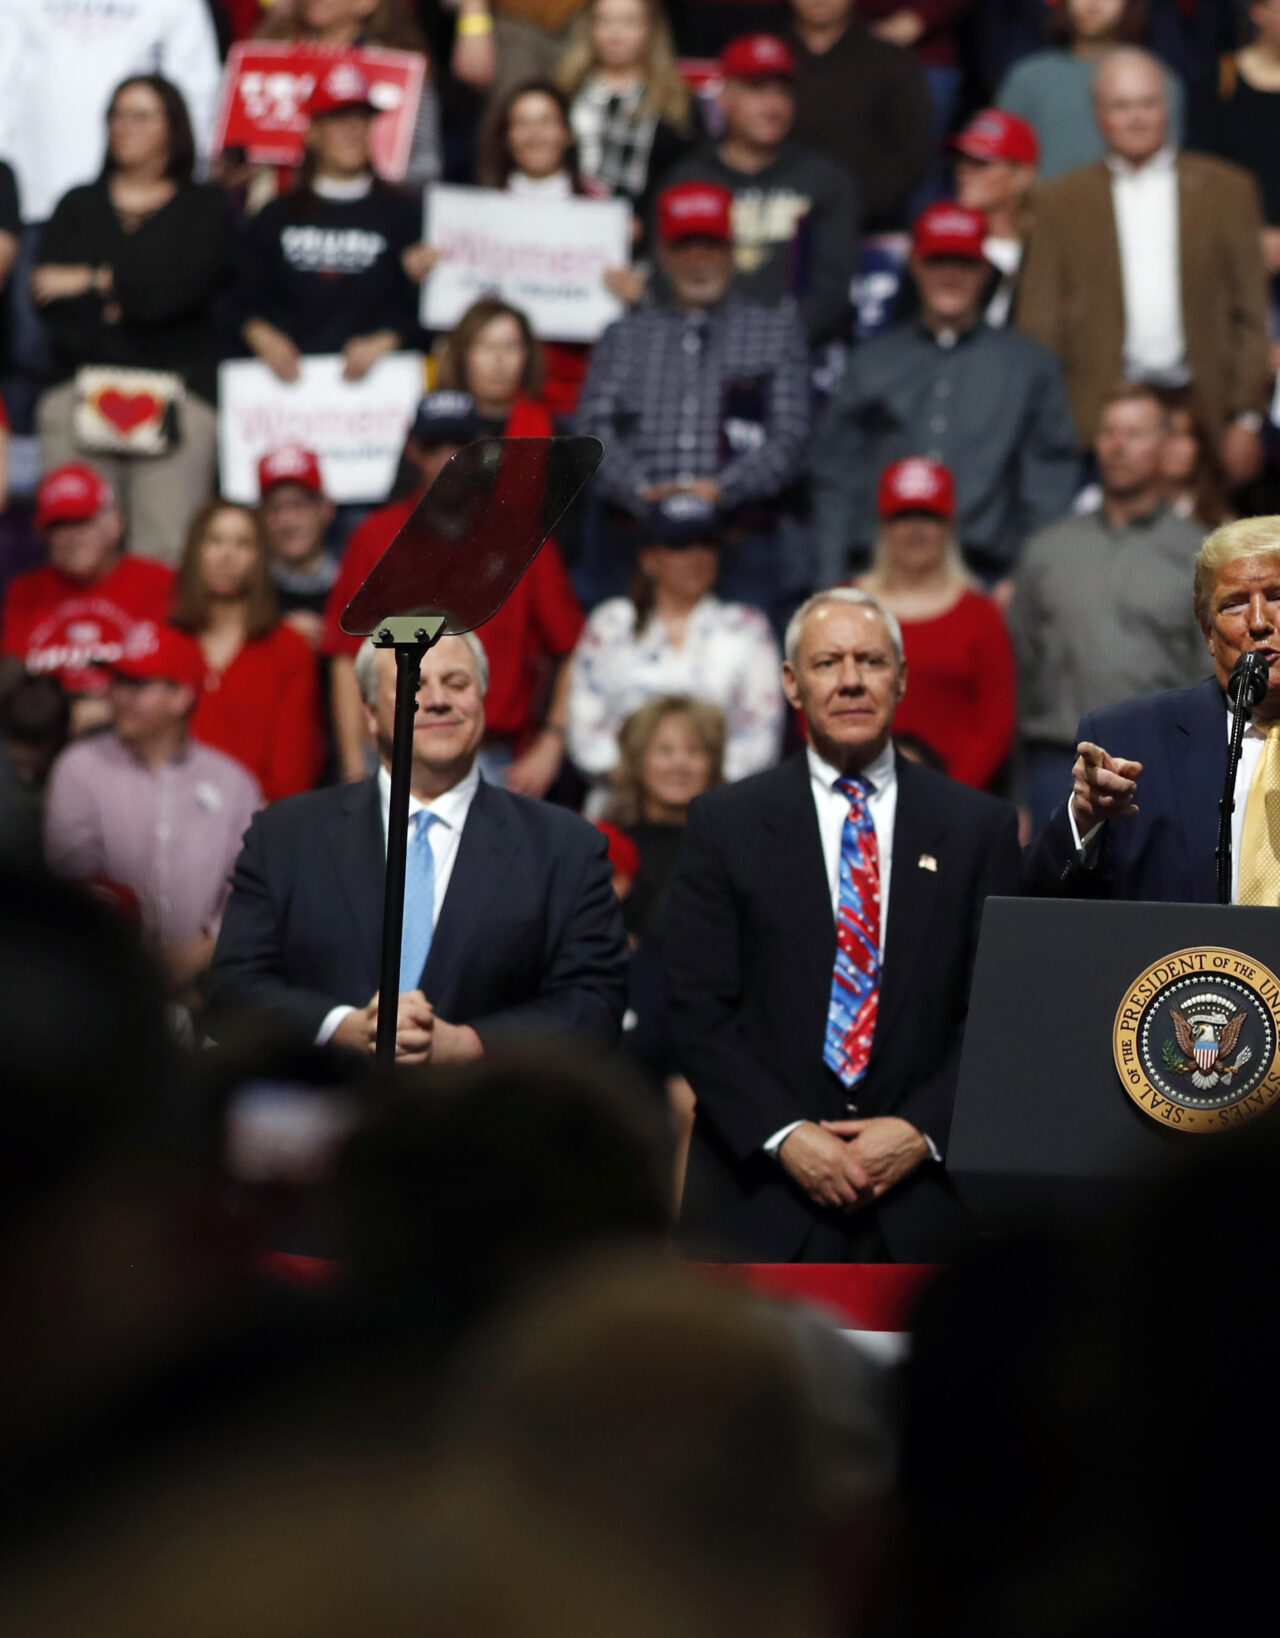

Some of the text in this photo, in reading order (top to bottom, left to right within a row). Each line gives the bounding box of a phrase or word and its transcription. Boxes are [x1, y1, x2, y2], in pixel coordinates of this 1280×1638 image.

[1212, 956, 1231, 969] OF
[1234, 961, 1257, 980] THE
[1120, 953, 1208, 1033] PRESIDENT
[1121, 1039, 1134, 1066] THE
[1126, 1068, 1141, 1085] OF
[1139, 1084, 1185, 1124] SEAL
